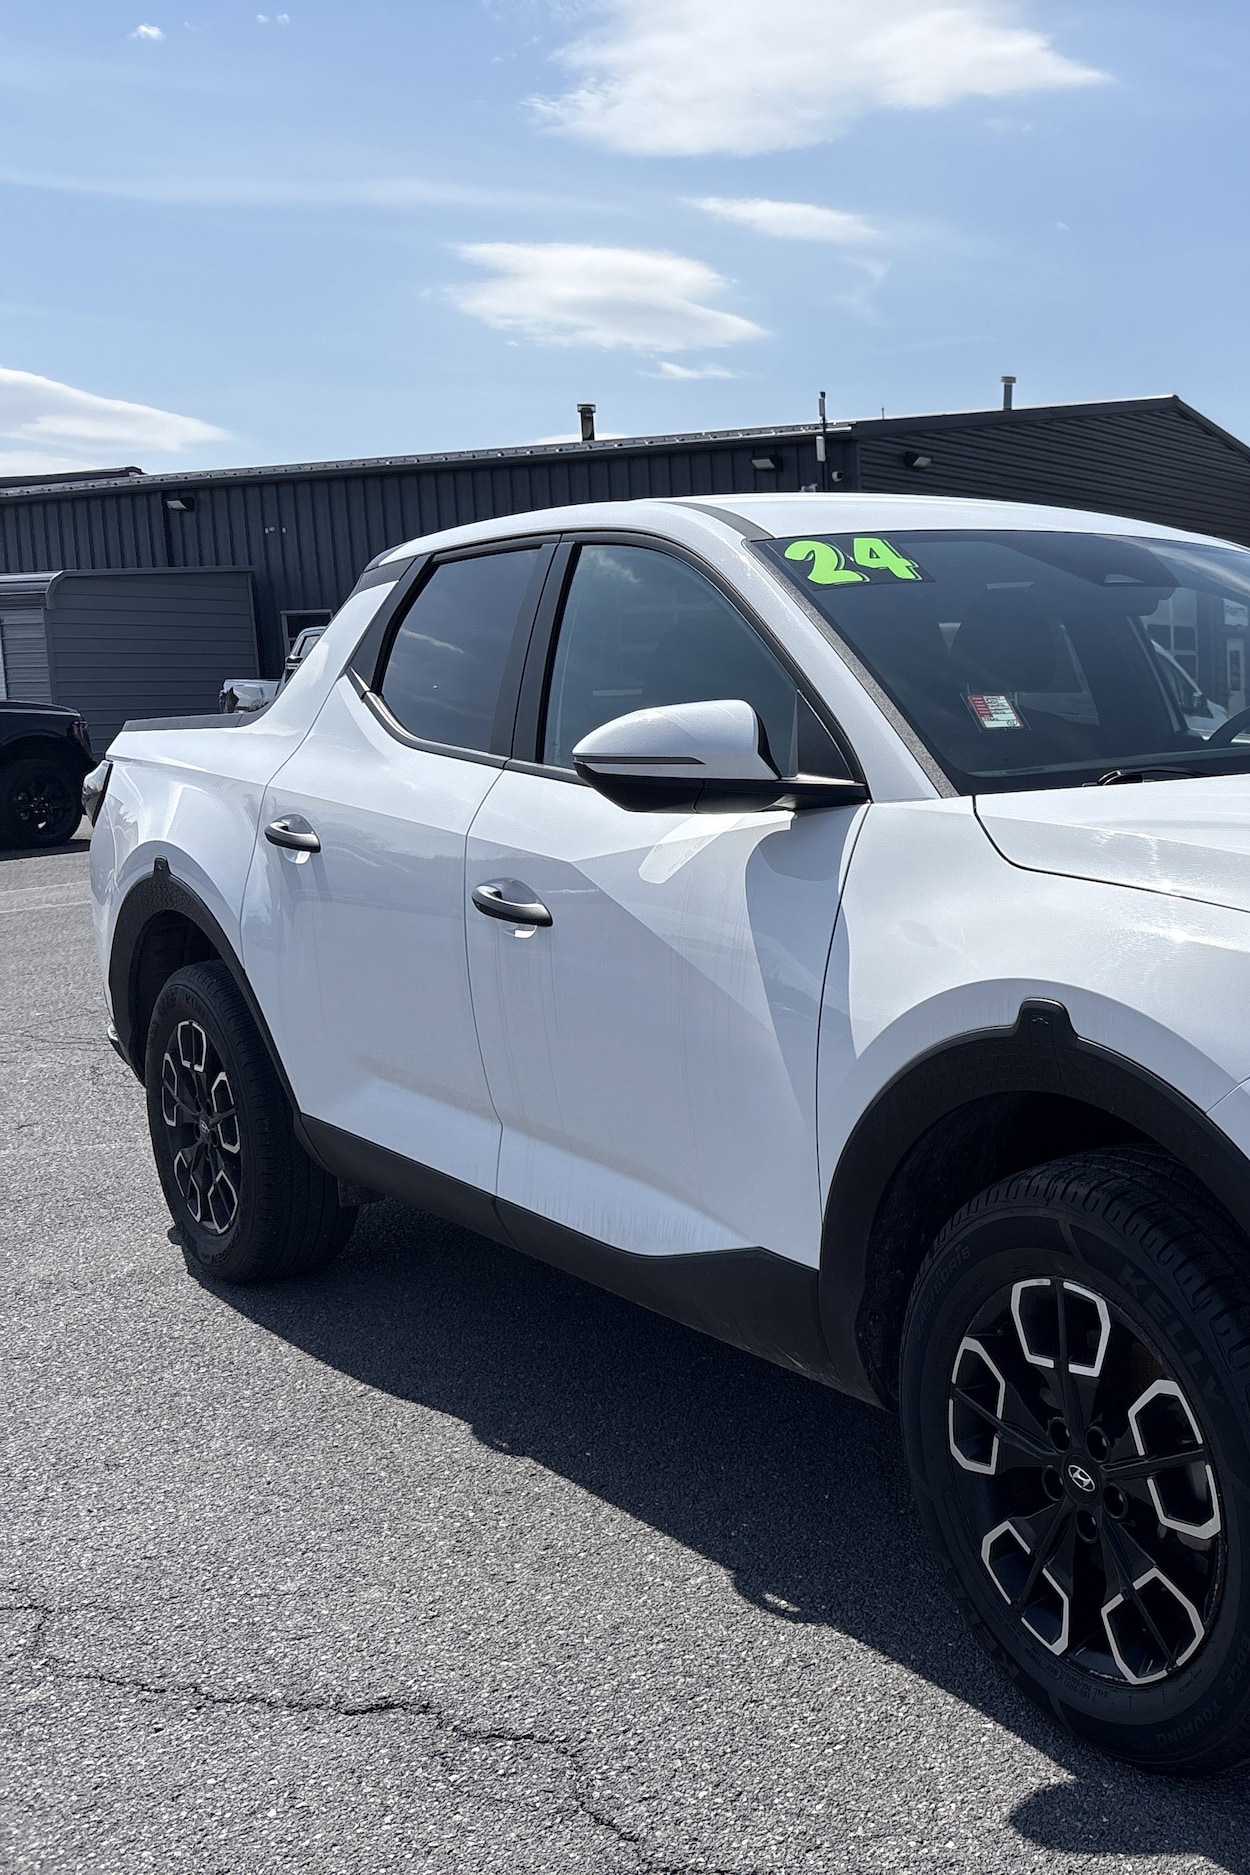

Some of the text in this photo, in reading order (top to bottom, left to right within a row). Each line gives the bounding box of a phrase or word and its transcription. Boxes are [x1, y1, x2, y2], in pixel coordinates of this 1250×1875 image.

[784, 537, 922, 585] 24
[1118, 1264, 1227, 1405] KELLY
[1156, 1698, 1224, 1746] TOURING
